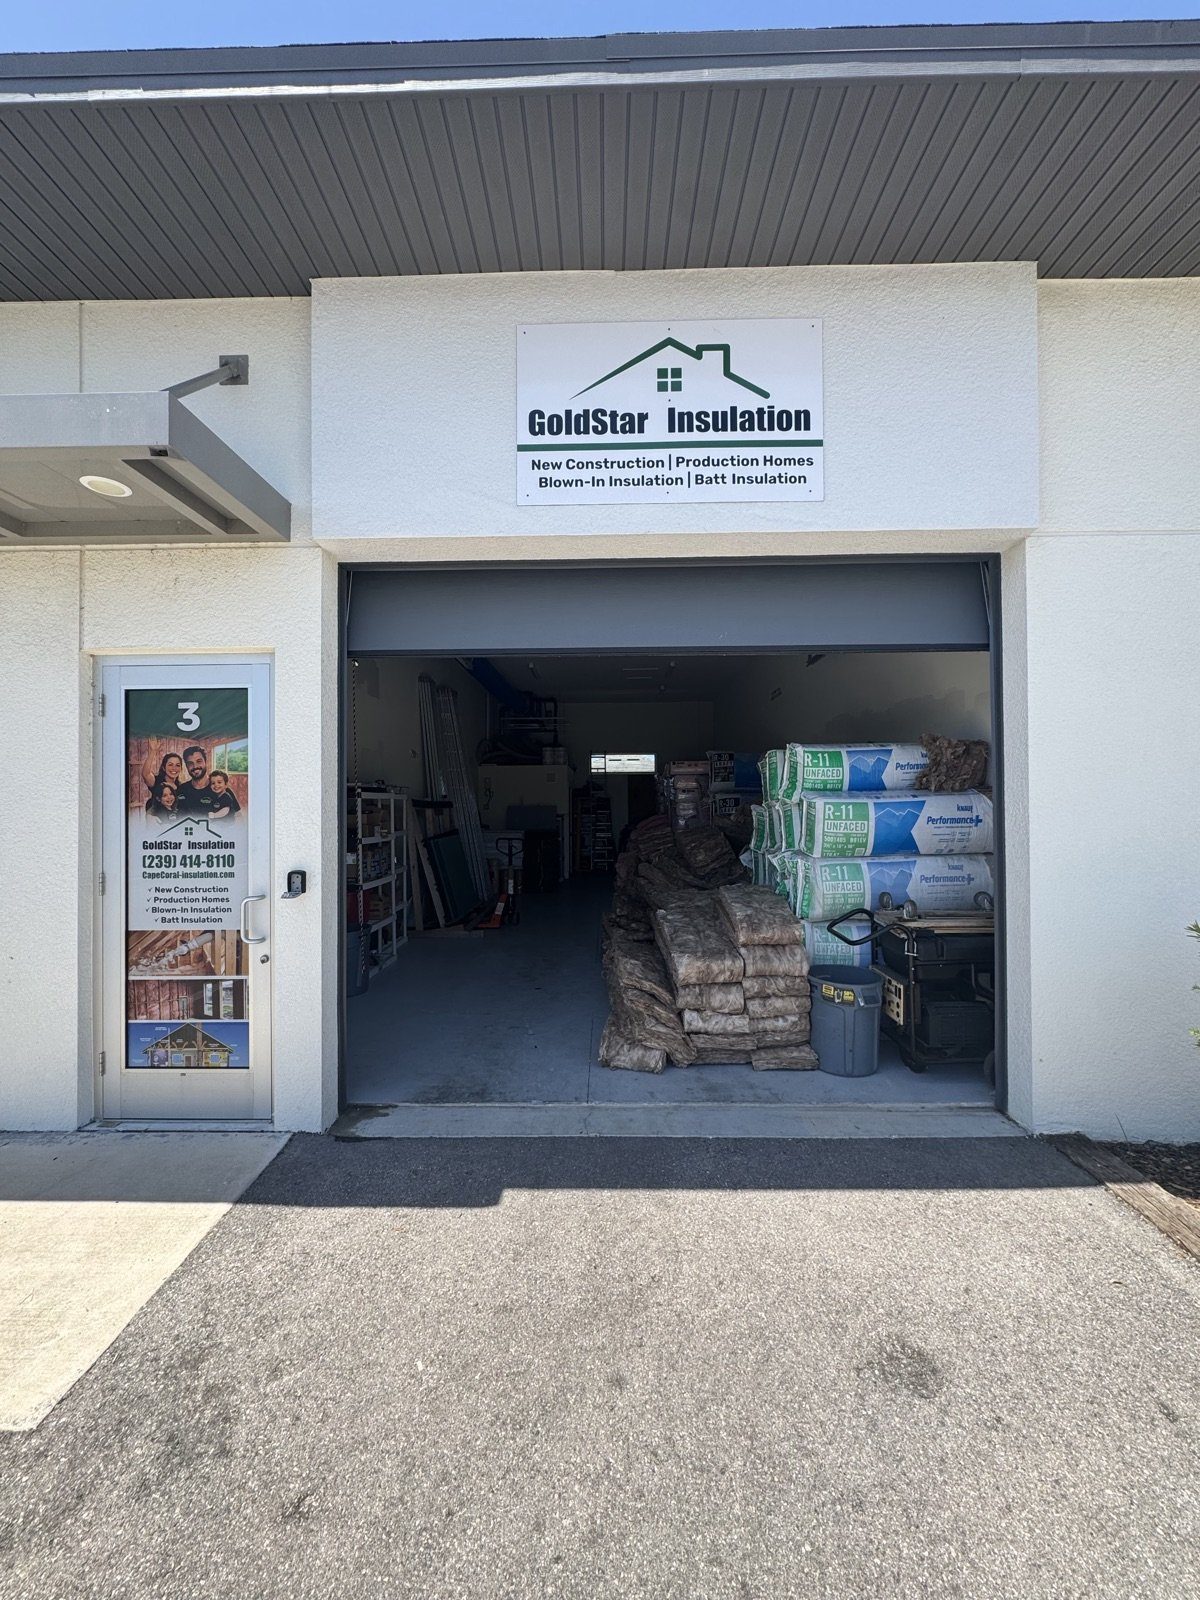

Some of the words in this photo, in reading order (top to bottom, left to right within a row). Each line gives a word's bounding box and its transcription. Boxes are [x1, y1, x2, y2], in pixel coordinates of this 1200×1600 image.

[528, 408, 649, 436] GoldStar
[667, 405, 811, 433] Insulation
[531, 459, 563, 471] New
[565, 456, 665, 470] Construction
[675, 455, 760, 468] Production
[763, 455, 814, 467] Homes
[538, 475, 605, 488] Blown-In
[609, 474, 684, 487] Insulation
[694, 473, 727, 485] Batt
[731, 472, 807, 485] Insulation
[176, 701, 201, 732] 3
[804, 752, 830, 766] R-11
[805, 768, 841, 778] UNFACED
[825, 804, 853, 819] R-11
[826, 822, 866, 831] UNFACED
[142, 840, 182, 850] GoldStar
[187, 840, 235, 850] Insulation
[142, 854, 177, 869] (239)
[179, 854, 235, 868] 414-8110
[142, 871, 235, 879] CapeCoral-insulation.com
[822, 865, 849, 880] R-11
[173, 885, 229, 893] Construction
[825, 881, 862, 892] UNFACED
[151, 906, 189, 914] Blown-In
